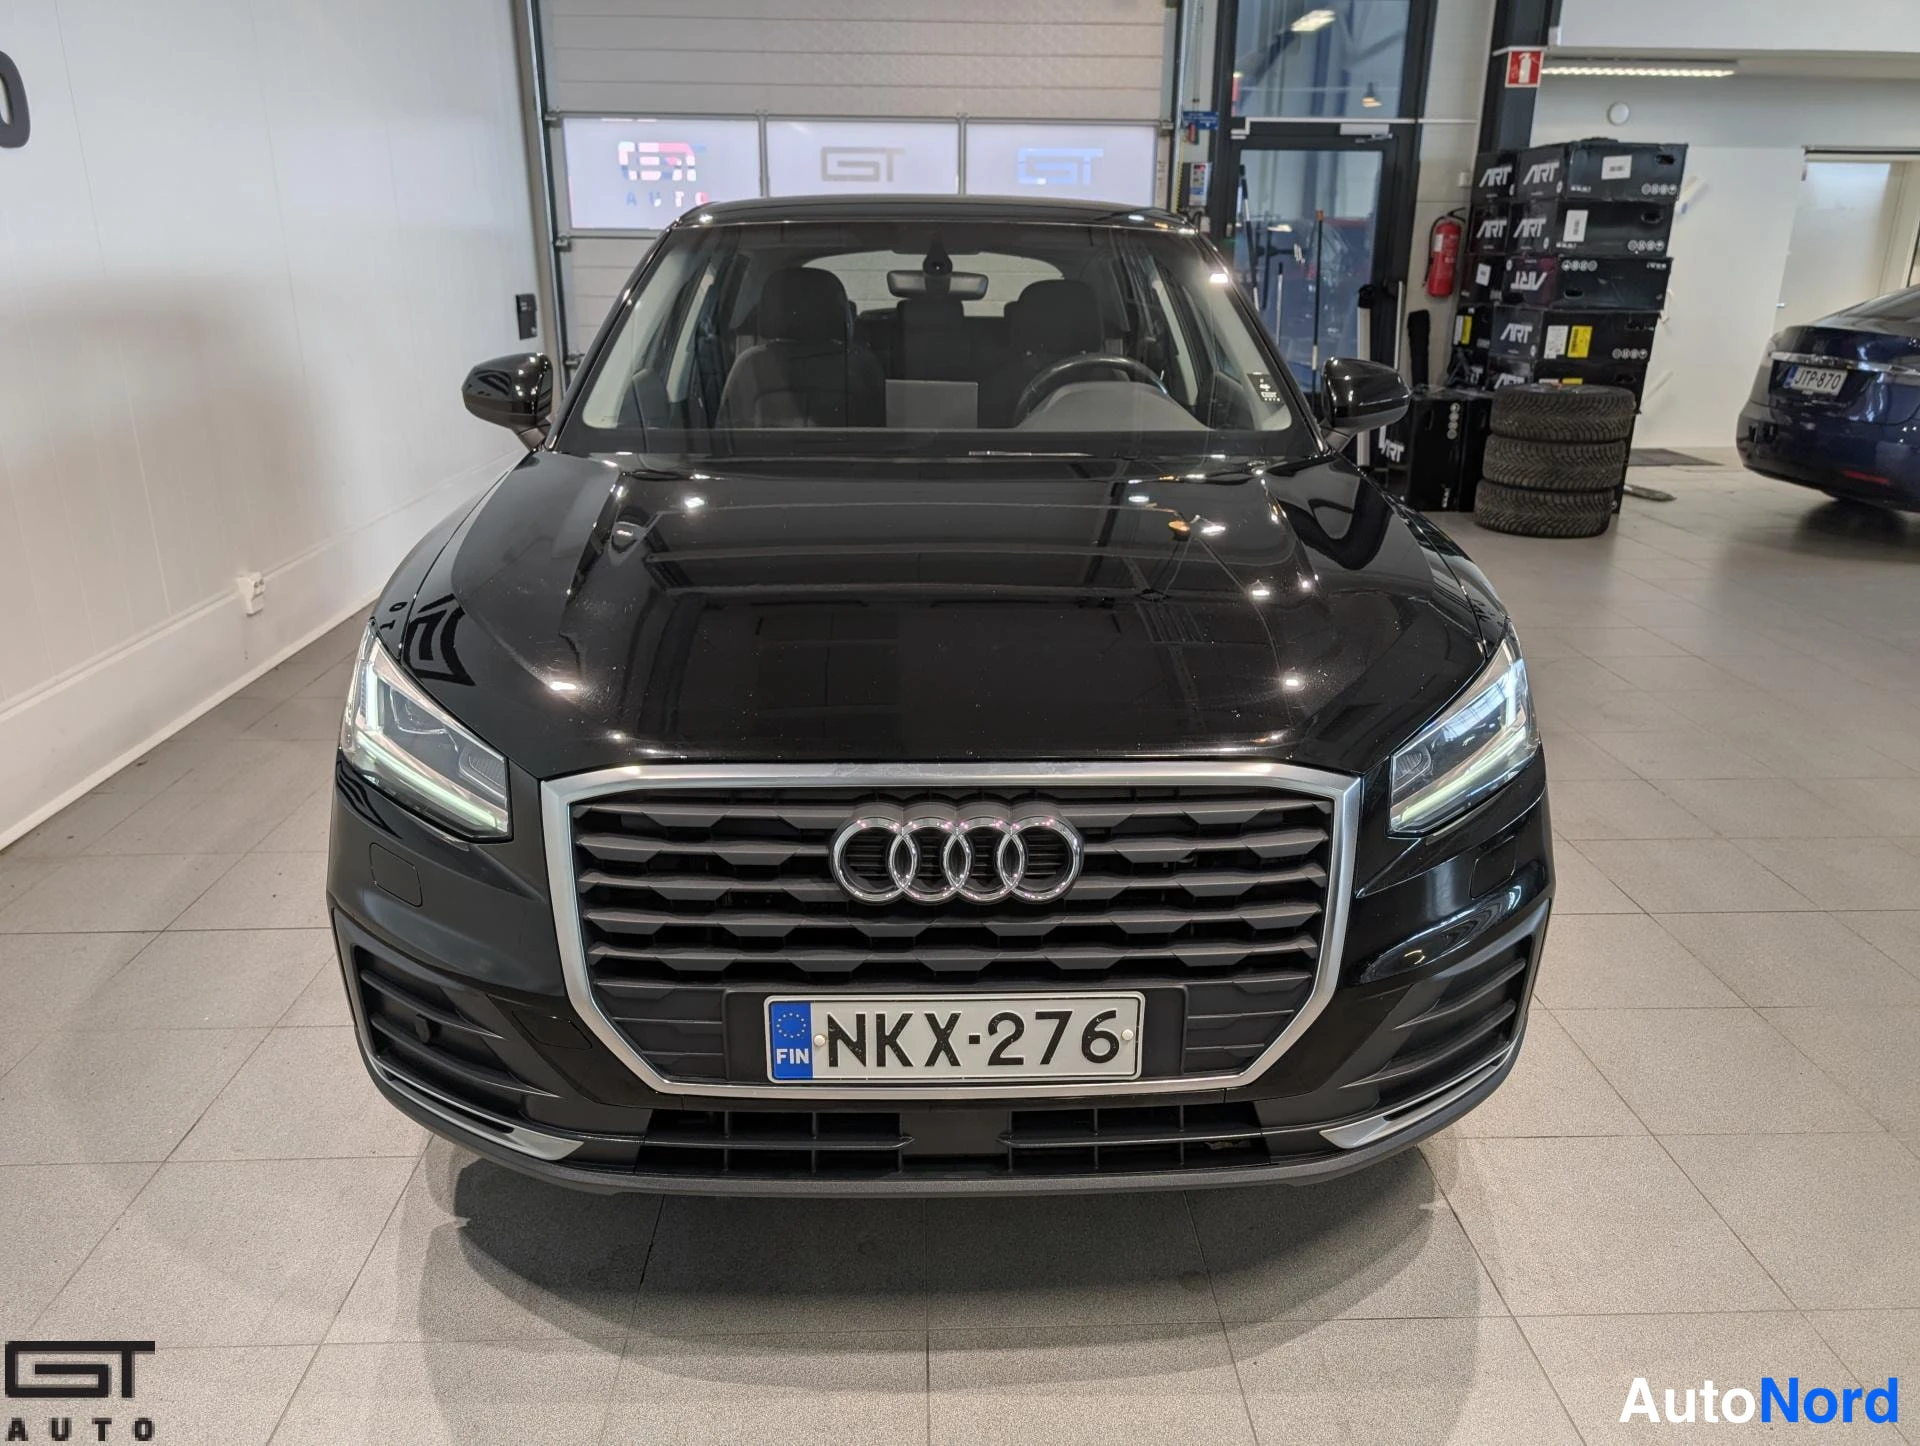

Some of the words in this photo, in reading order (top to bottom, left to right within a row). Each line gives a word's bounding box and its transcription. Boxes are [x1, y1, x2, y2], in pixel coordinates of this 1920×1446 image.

[1479, 165, 1513, 188] ART
[1523, 161, 1560, 185] ART
[1476, 219, 1507, 238] ART
[1513, 217, 1547, 238] ART
[1511, 271, 1547, 291] ART
[1500, 322, 1533, 344] ART
[1794, 369, 1842, 390] JTP-870
[826, 1009, 1120, 1067] NKX-276
[776, 1048, 810, 1065] FIN
